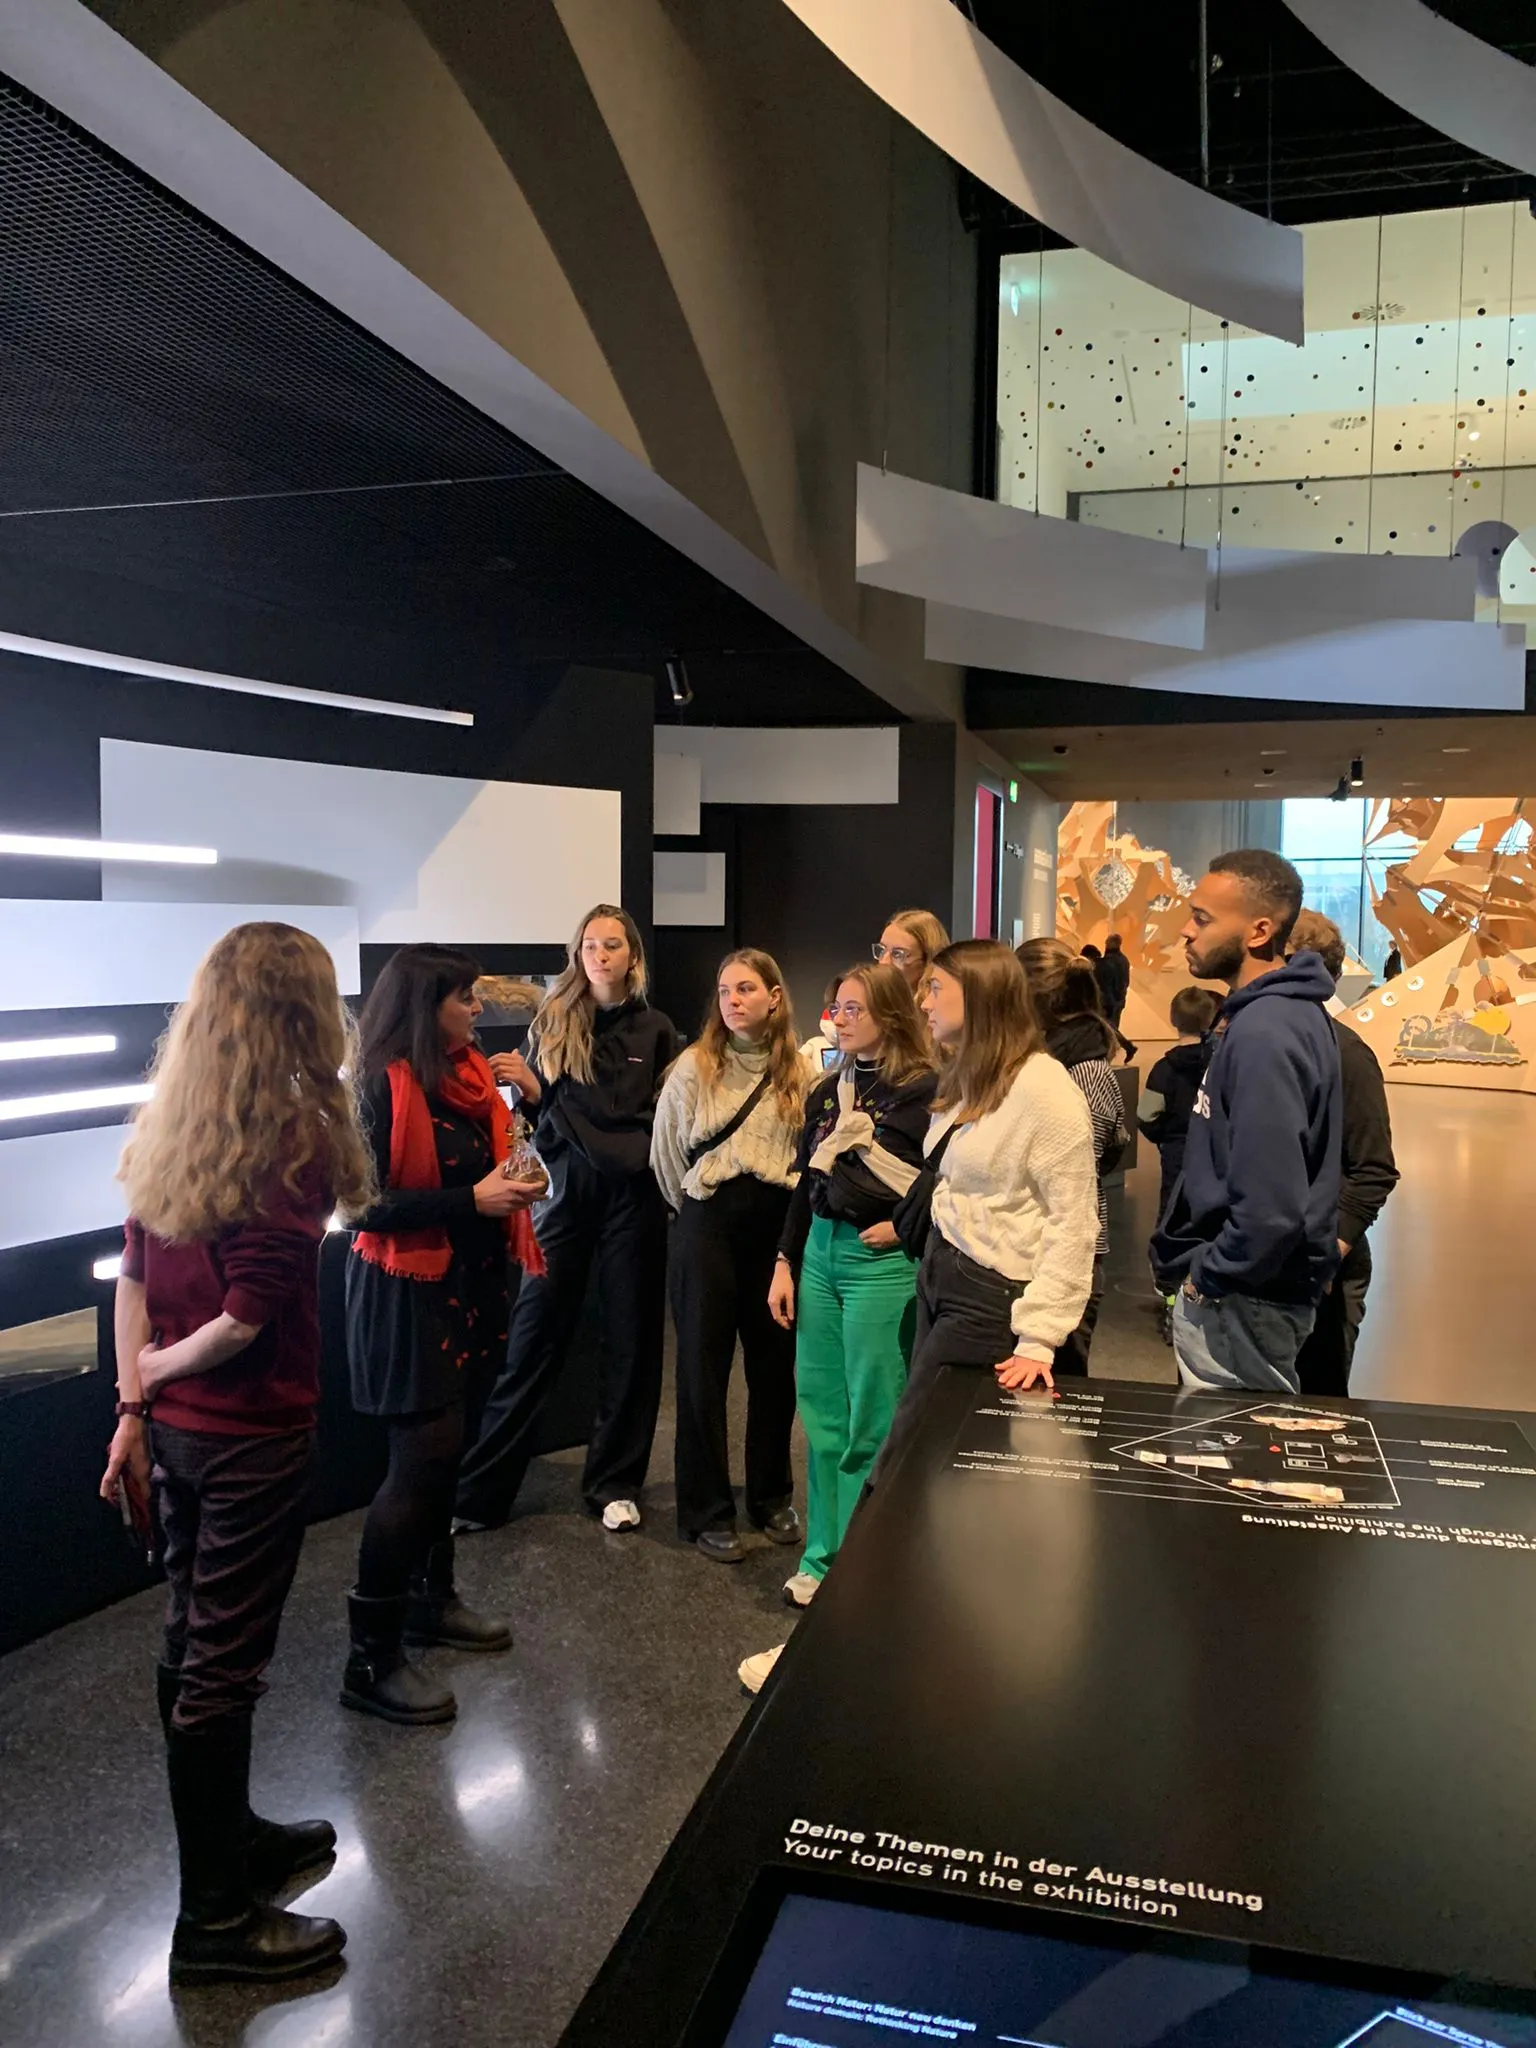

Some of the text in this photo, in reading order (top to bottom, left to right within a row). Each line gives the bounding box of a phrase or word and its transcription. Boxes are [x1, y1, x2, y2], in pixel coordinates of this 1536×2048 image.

[1241, 1514, 1353, 1533] Ausstellung
[1314, 1514, 1406, 1530] exhibition
[1411, 1523, 1443, 1534] the
[1359, 1526, 1388, 1537] die
[1394, 1530, 1450, 1542] durch
[1448, 1527, 1526, 1541] through
[789, 1818, 1263, 1911] Deine Themen in der Ausstellung
[784, 1838, 1178, 1917] Your topics in the exhibition
